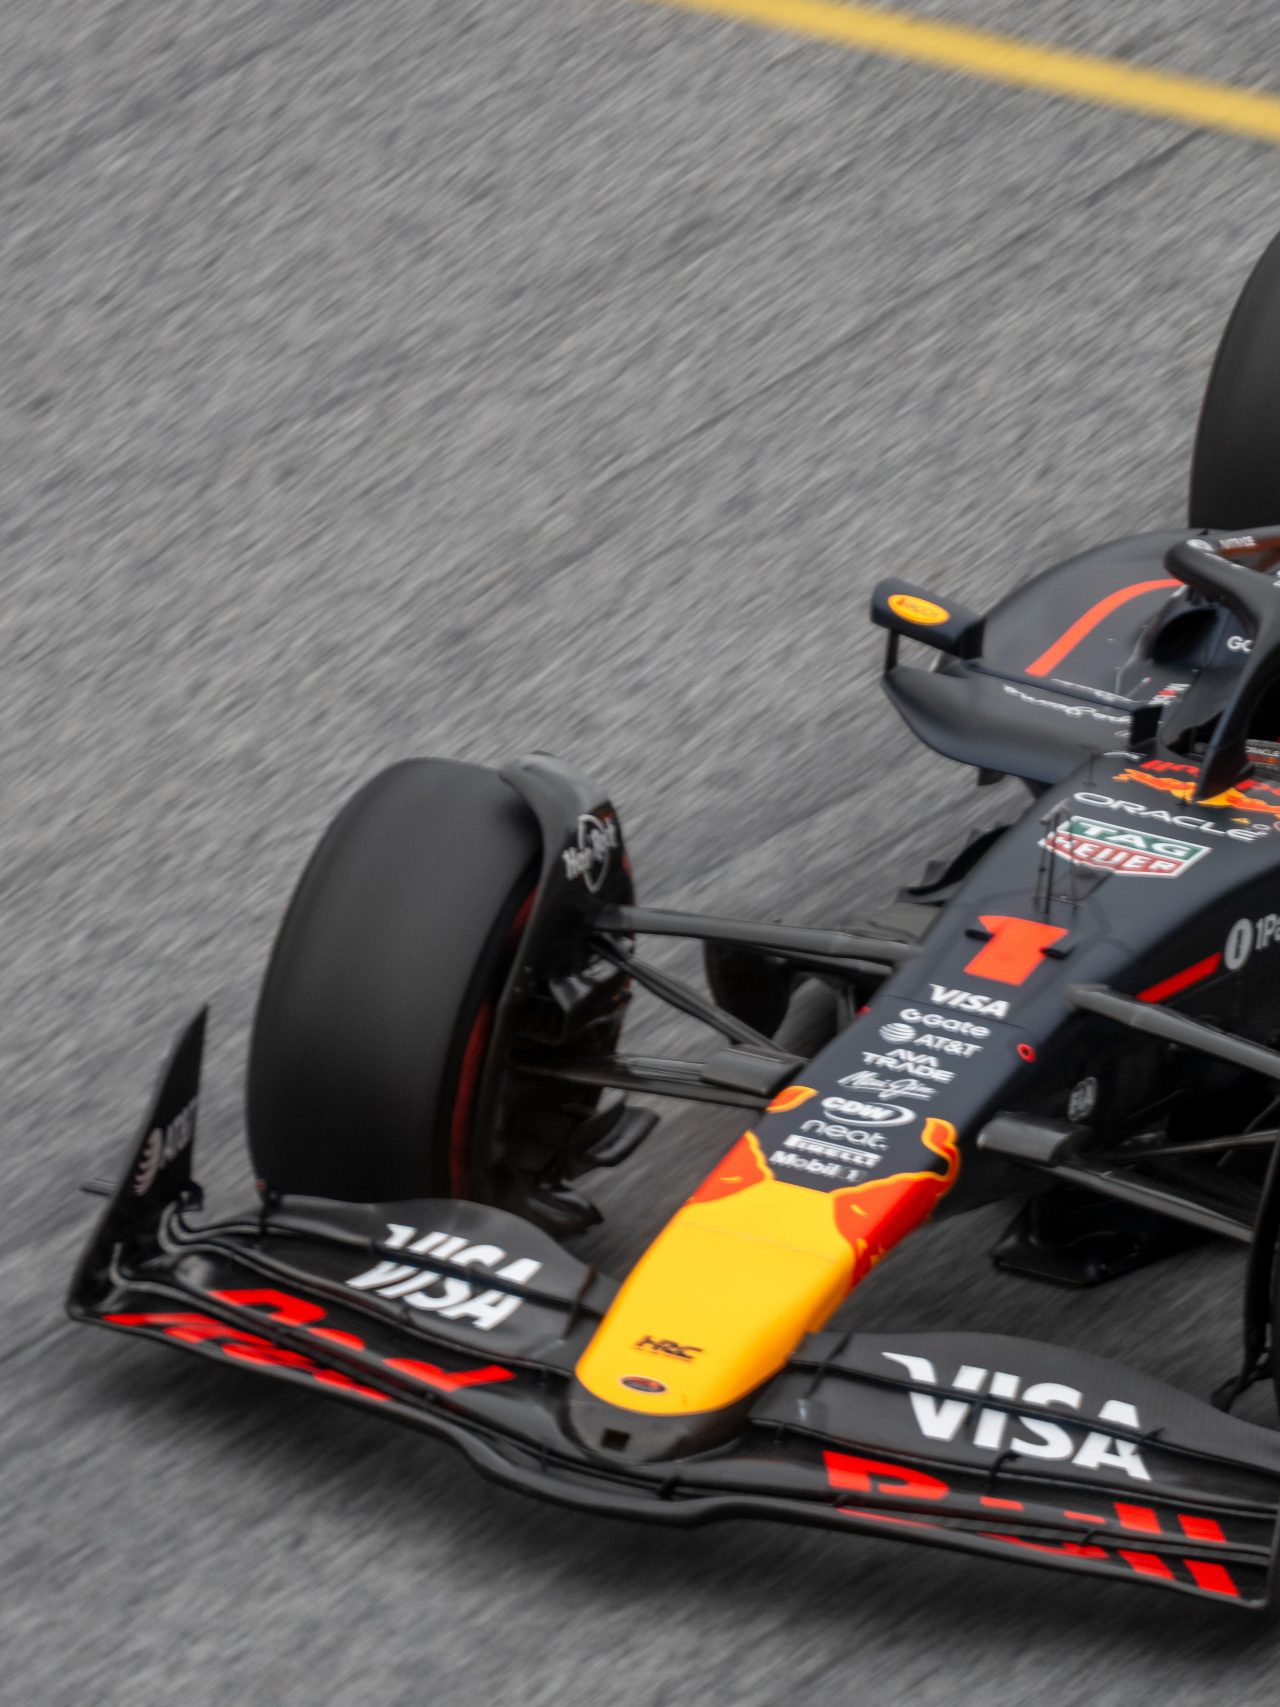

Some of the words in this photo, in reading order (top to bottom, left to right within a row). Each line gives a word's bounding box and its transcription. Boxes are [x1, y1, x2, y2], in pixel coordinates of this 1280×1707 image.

[1073, 791, 1260, 844] ORACLE
[1055, 835, 1177, 873] HEUER
[1079, 821, 1191, 857] TAG
[963, 915, 1070, 987] 1
[929, 983, 1011, 1019] VISA
[922, 1013, 992, 1040] Gate
[885, 1048, 940, 1068] AVA
[913, 1033, 985, 1059] AT&T
[862, 1050, 956, 1085] TRADE
[821, 1096, 896, 1121] CDW
[769, 1150, 842, 1179] Mobil
[783, 1133, 882, 1169] PIRELLI
[346, 1223, 543, 1331] VISA
[634, 1335, 703, 1361] HRC
[883, 1350, 1151, 1482] VISA
